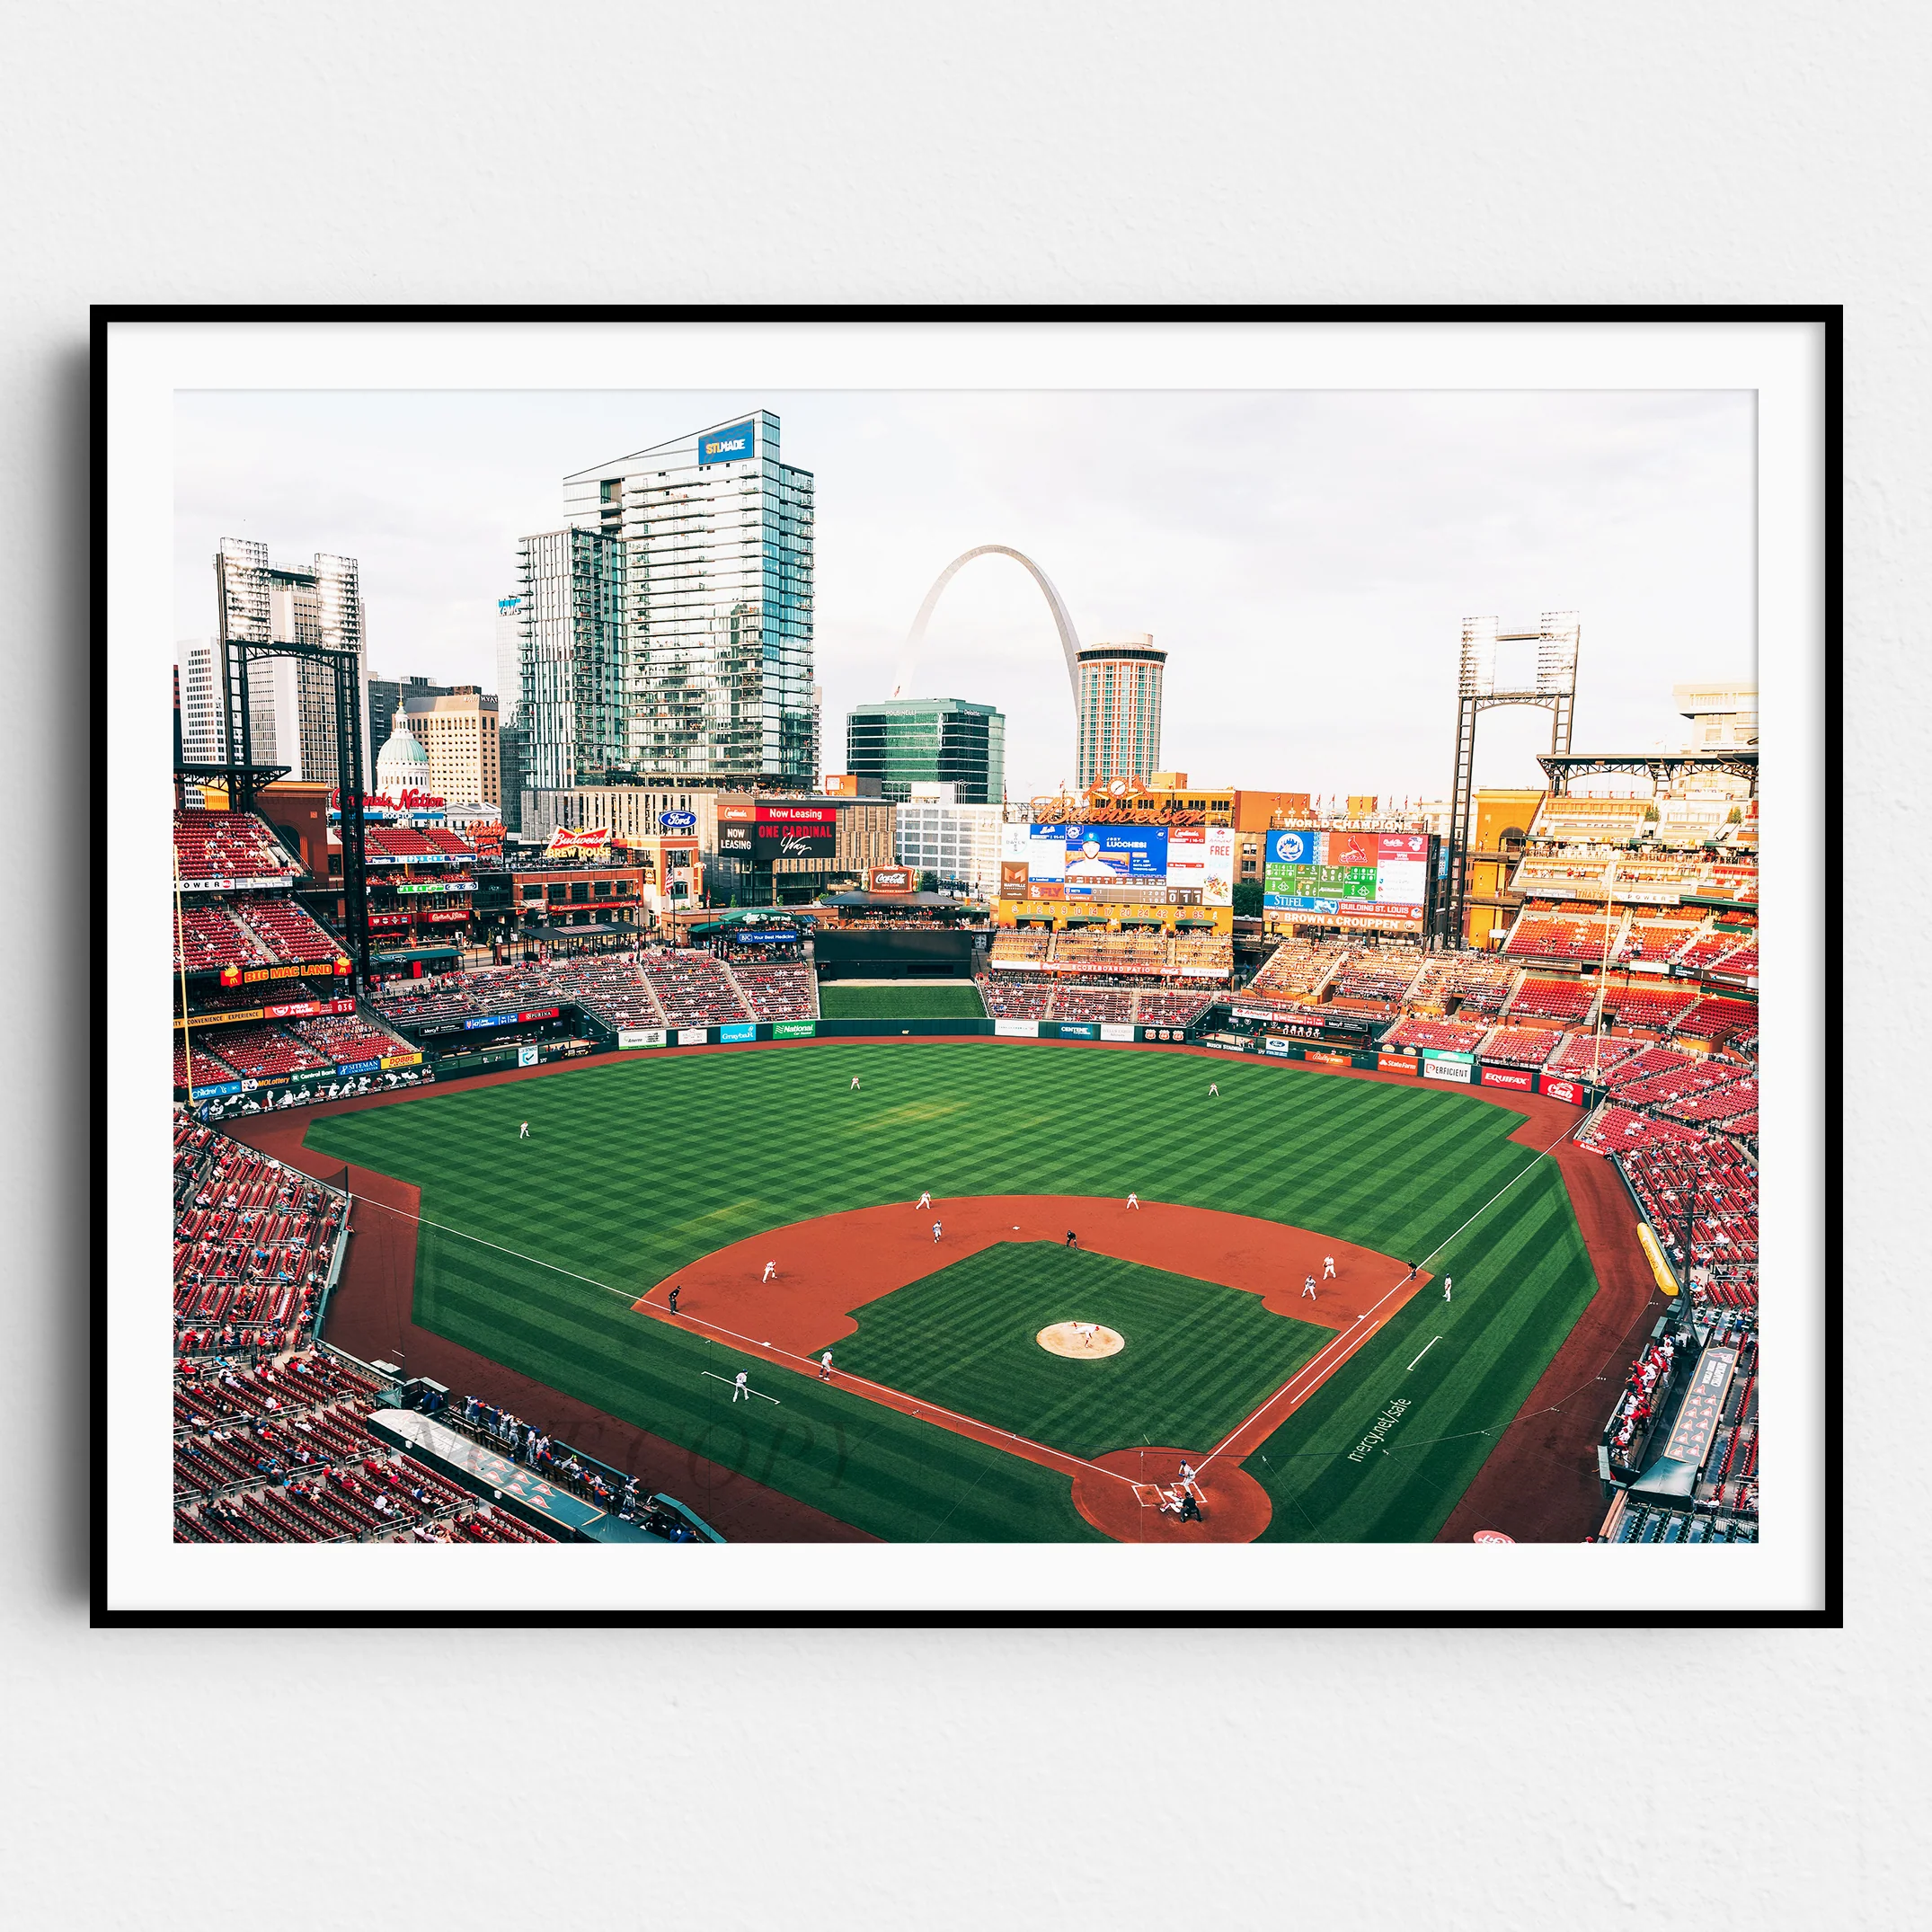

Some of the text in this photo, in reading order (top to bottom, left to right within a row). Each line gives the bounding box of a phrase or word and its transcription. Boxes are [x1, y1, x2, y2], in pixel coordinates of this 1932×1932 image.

[394, 788, 445, 811] Nation
[769, 809, 788, 818] Now
[790, 809, 822, 820] Leasing
[1030, 796, 1207, 824] Budweiser
[668, 813, 691, 825] Ford
[1284, 819, 1413, 829] WORLD CHAMPIONS
[727, 829, 745, 837] NOW
[758, 826, 832, 837] ONE CARDINAL
[548, 833, 610, 846] Budweiser
[721, 840, 751, 850] LEASING
[780, 833, 812, 855] Way
[546, 847, 611, 858] BREW HOUSE
[1210, 846, 1230, 855] FREE
[875, 873, 907, 884] Coca-Cola
[1040, 888, 1061, 897] FLY
[1169, 893, 1201, 903] 0 1 1
[1578, 891, 1604, 899] THAT'S
[1274, 895, 1304, 907] STIFEL
[1036, 906, 1042, 914] 2
[1074, 907, 1082, 915] 10
[1089, 908, 1097, 916] 14
[1104, 908, 1113, 916] 17
[1121, 908, 1131, 916] 20
[1138, 908, 1149, 917] 24
[1157, 909, 1167, 917] 42
[1174, 909, 1186, 918] 45
[1193, 910, 1204, 918] 85
[1341, 903, 1373, 911] BUILDING
[1387, 906, 1408, 914] LOUIS
[1284, 913, 1325, 924] BROWN
[1335, 917, 1396, 929] CROUPPEN
[244, 963, 332, 983] BIG MAC LAND
[1071, 964, 1123, 972] SCOREBOARD
[188, 1015, 223, 1025] CONVENIENCE
[228, 1011, 259, 1020] EXPERIENCE
[784, 1024, 813, 1032] National
[1223, 1044, 1244, 1052] STADIUM
[389, 1055, 414, 1065] DOBBS
[1312, 1052, 1330, 1063] Bally
[349, 1061, 378, 1070] SITEMAN
[1426, 1063, 1468, 1078] PERFICIENT
[300, 1068, 336, 1080] Central Bank
[1484, 1073, 1527, 1086] EQUIFAX
[1546, 1084, 1573, 1100] Club
[1348, 1398, 1412, 1463] mercy.net/safe
